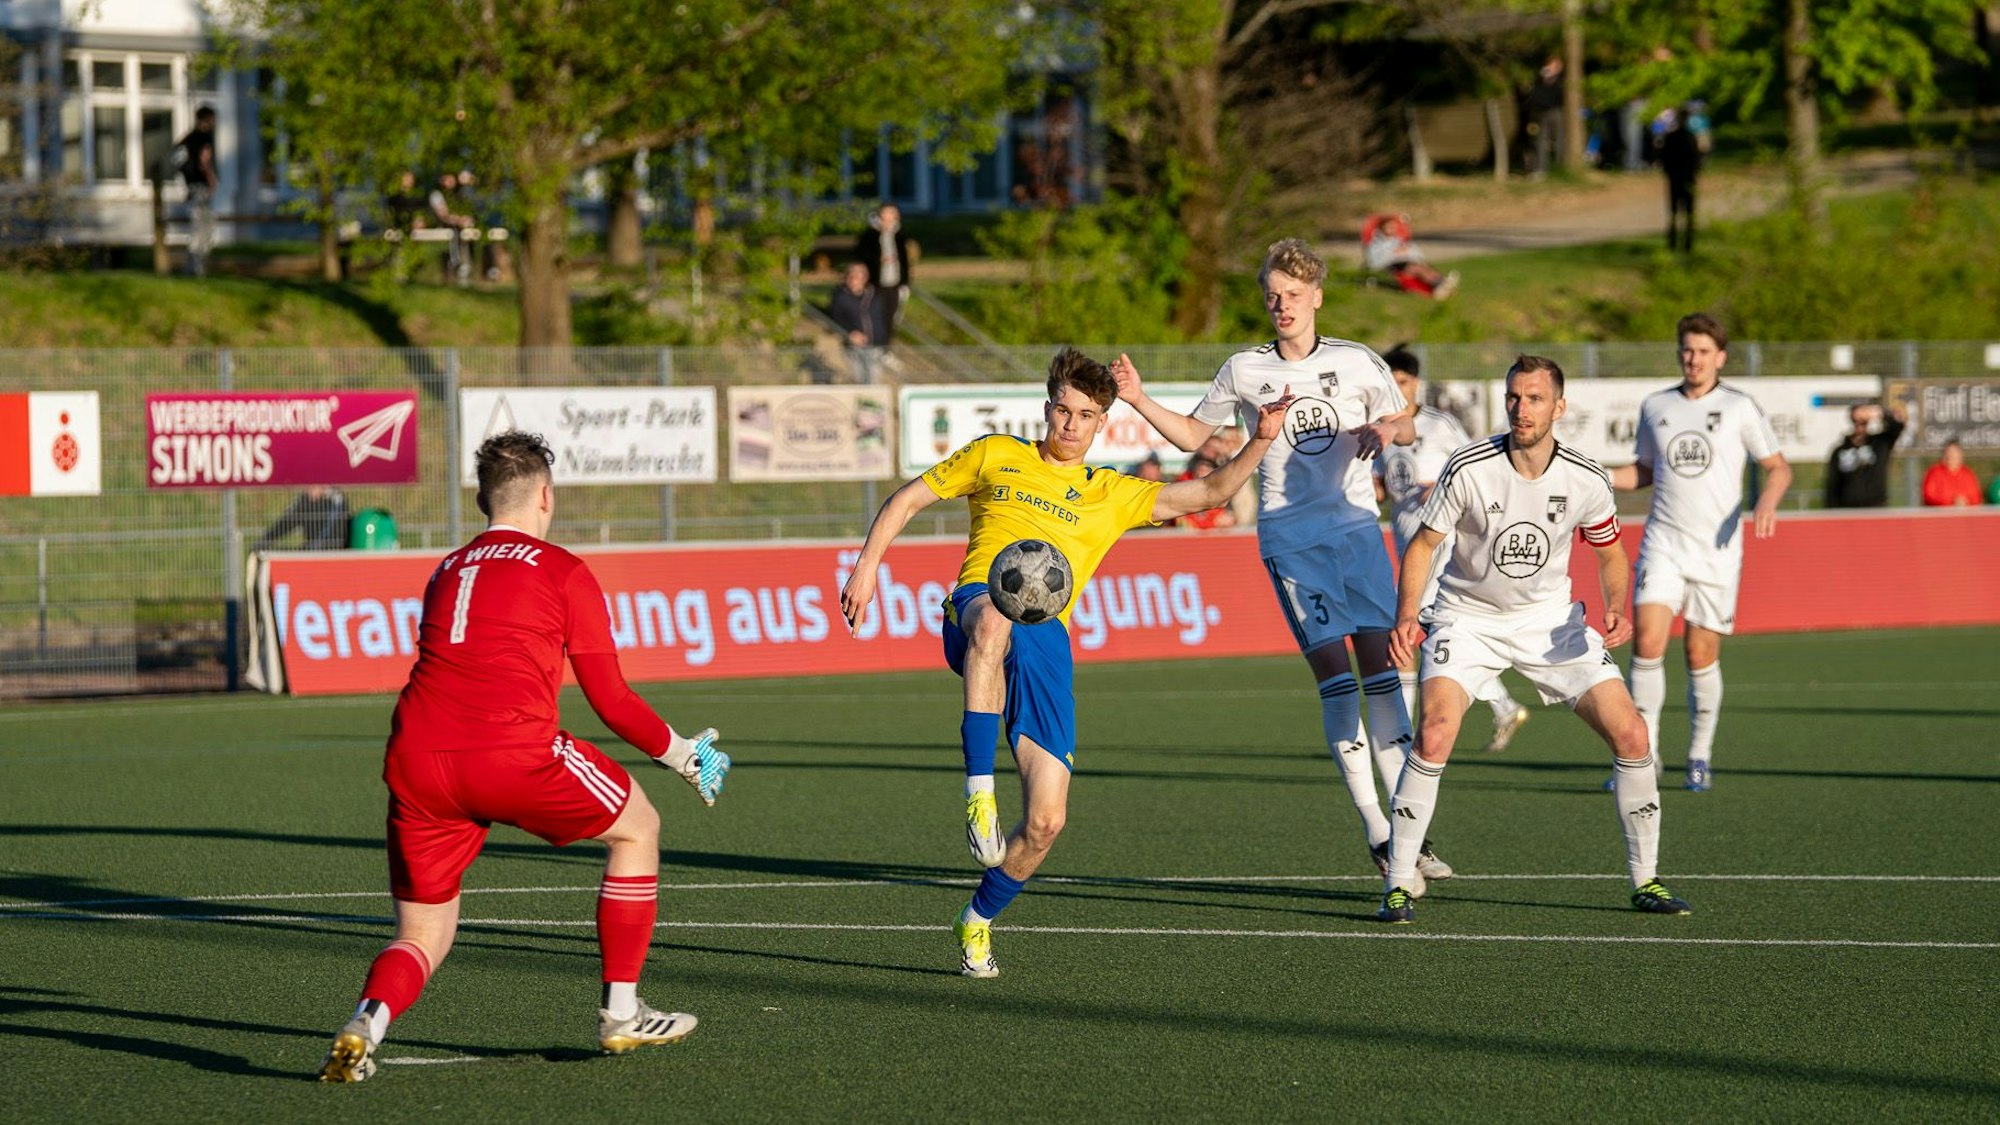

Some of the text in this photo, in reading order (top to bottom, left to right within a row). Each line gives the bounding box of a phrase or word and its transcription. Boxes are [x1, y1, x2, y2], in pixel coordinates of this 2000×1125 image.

[151, 434, 273, 484] SIMONS
[999, 466, 1021, 474] JAKO
[1015, 491, 1080, 527] SARSTEDT
[464, 543, 543, 567] WIEHL
[450, 564, 481, 645] 1
[725, 585, 830, 645] aus
[1308, 593, 1330, 625] 3
[1433, 639, 1450, 664] 5
